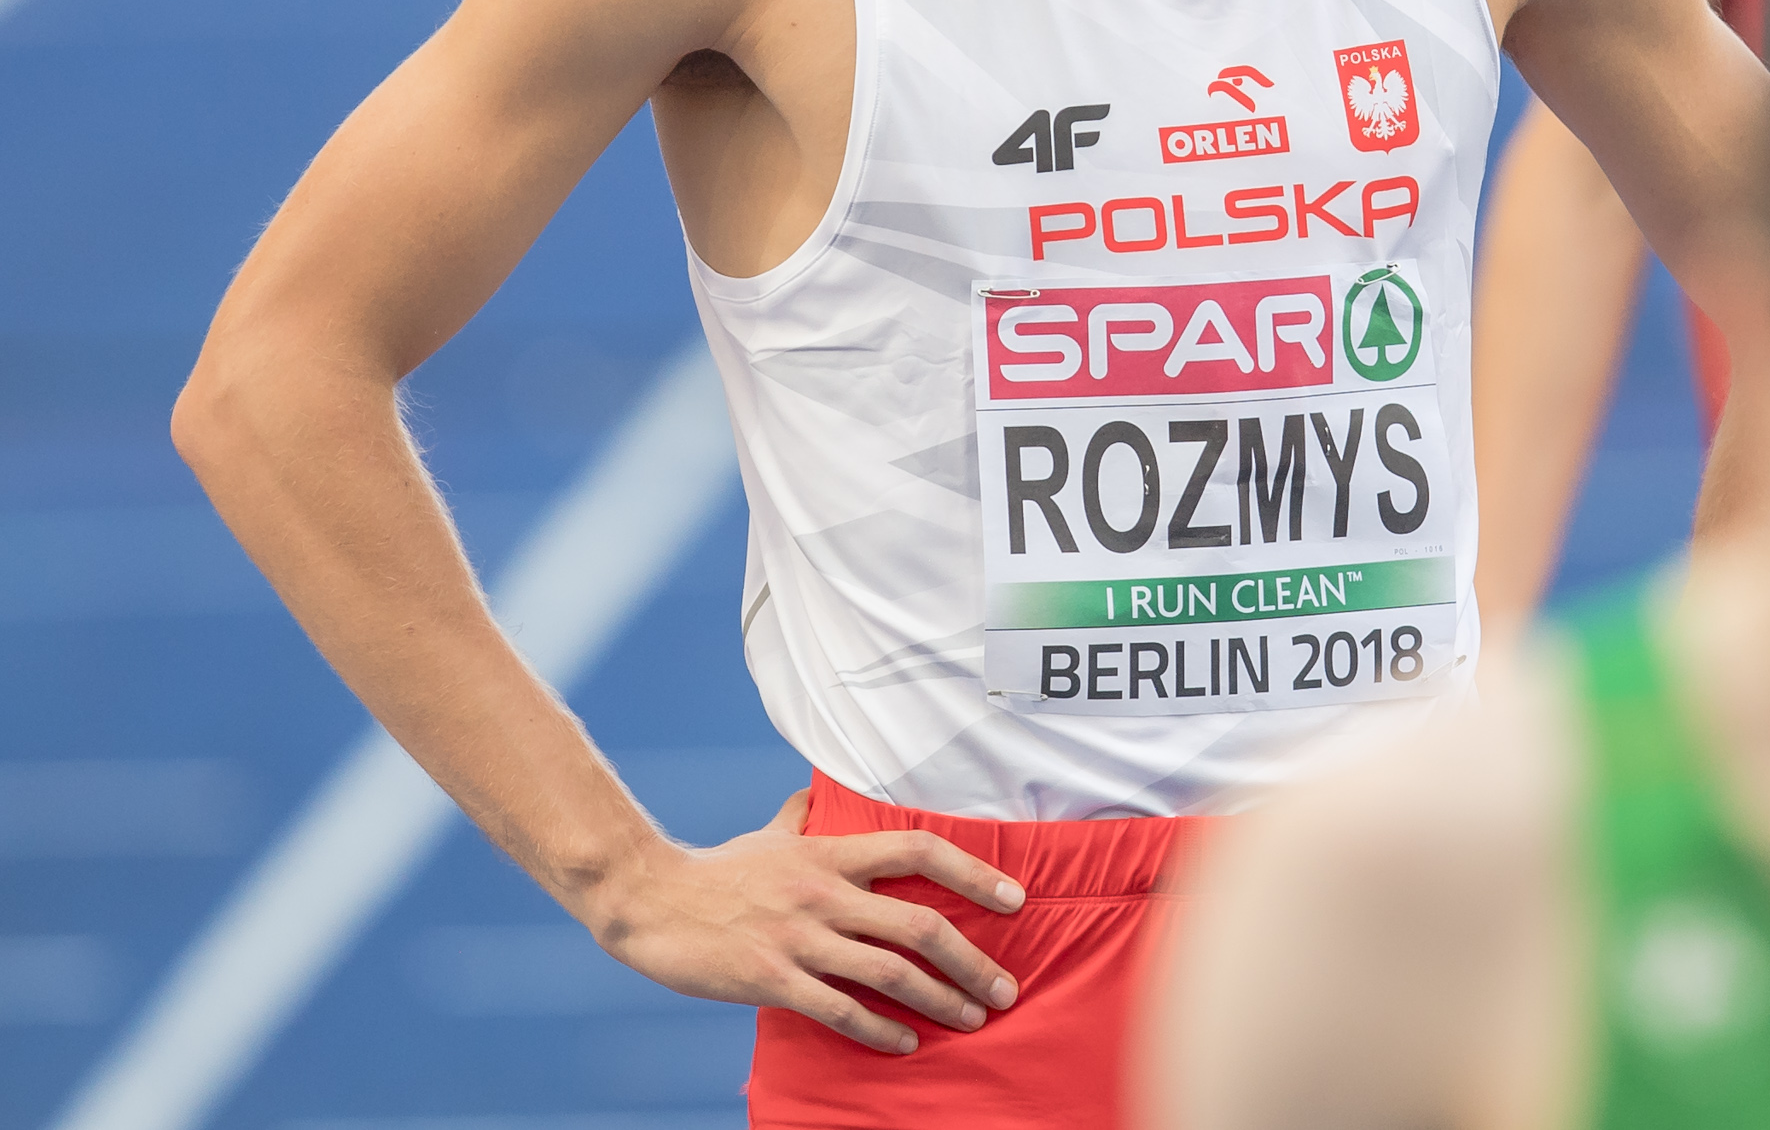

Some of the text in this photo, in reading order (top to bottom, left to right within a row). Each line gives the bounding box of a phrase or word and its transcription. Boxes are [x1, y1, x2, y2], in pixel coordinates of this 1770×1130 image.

[1339, 45, 1402, 67] POLSKA
[992, 103, 1111, 173] 4F
[1166, 121, 1283, 159] ORLEN
[1029, 175, 1420, 261] POLSKA
[997, 293, 1326, 382] SPAR
[1003, 403, 1430, 554] ROZMYS
[1106, 587, 1114, 619] I
[1130, 583, 1217, 619] RUN
[1040, 625, 1424, 701] BERLIN 2018
